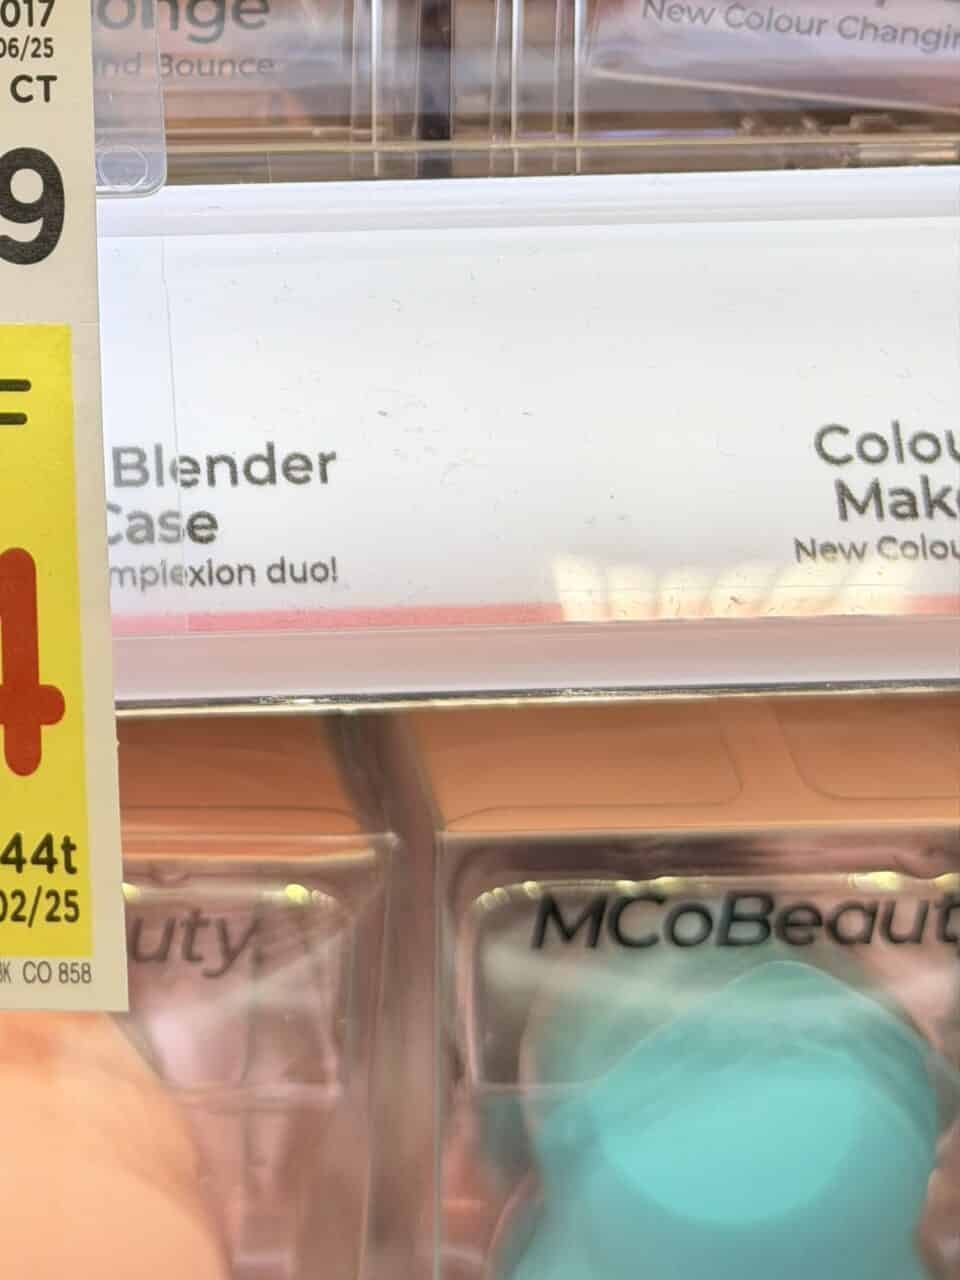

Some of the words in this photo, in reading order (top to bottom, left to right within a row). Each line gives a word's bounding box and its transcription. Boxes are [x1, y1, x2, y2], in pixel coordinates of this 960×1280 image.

[723, 1, 828, 38] Colour
[9, 73, 59, 104] CT
[111, 440, 338, 488] Blender
[834, 473, 960, 523] Mak
[793, 535, 869, 564] New
[266, 555, 338, 586] duo!
[531, 890, 960, 952] MCoBeaut
[22, 960, 54, 985] CO
[57, 961, 93, 985] 858
